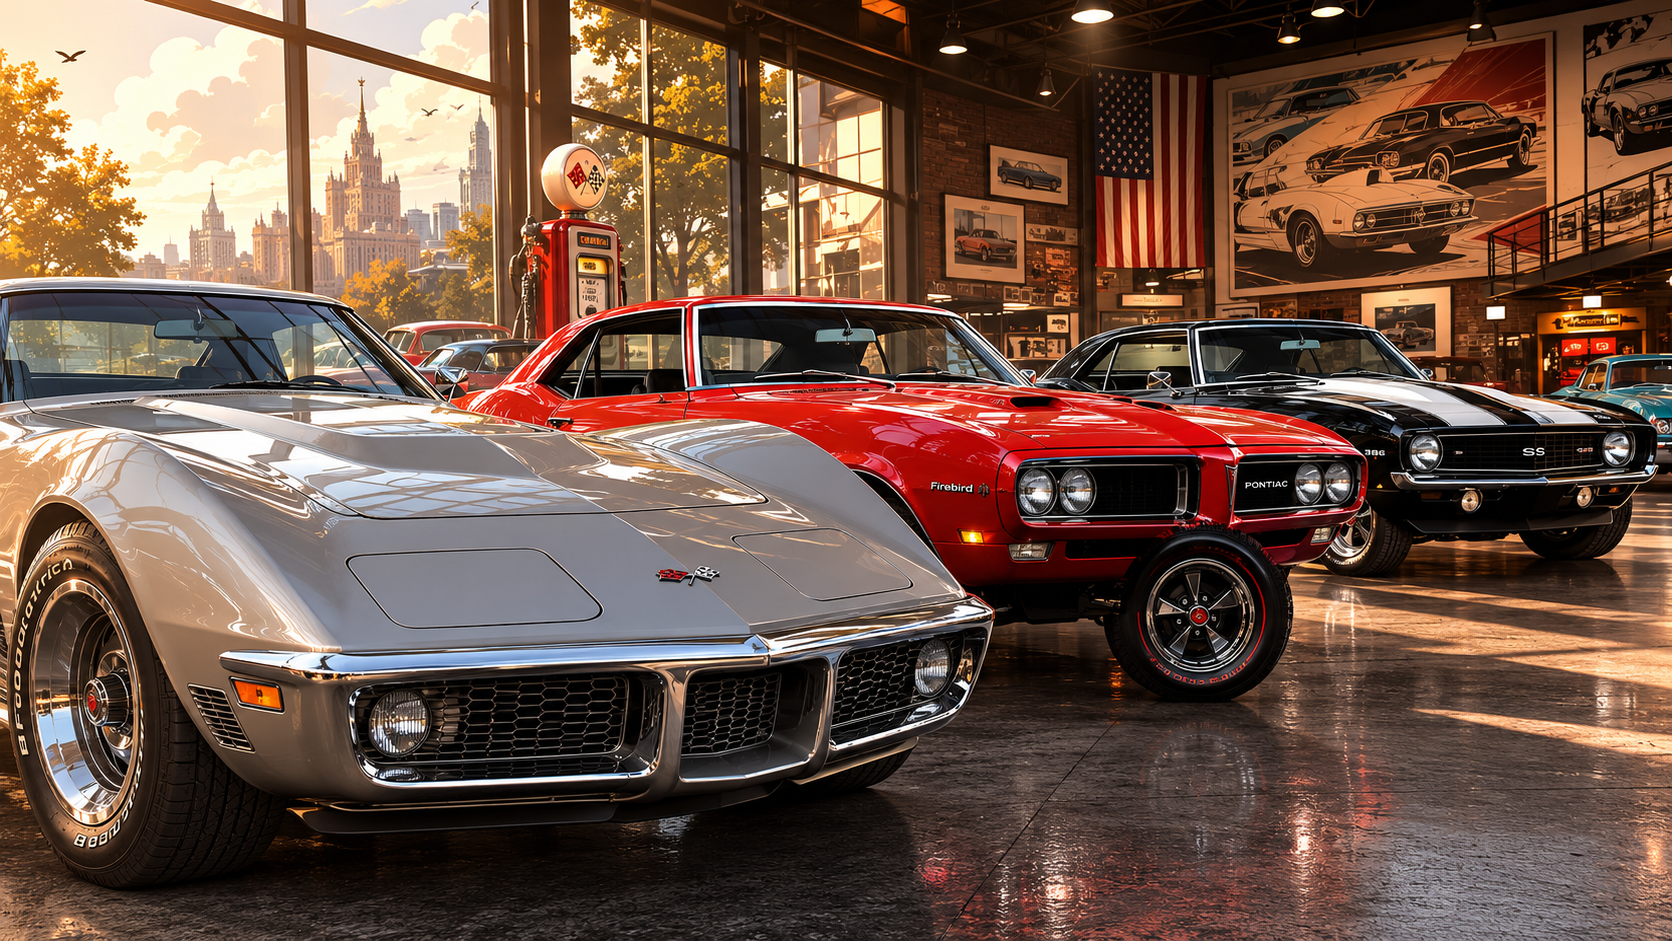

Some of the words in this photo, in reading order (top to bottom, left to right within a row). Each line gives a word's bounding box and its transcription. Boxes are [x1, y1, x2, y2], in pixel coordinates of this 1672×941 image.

[1522, 447, 1546, 457] SS
[930, 481, 974, 493] Firebird
[1245, 480, 1288, 489] PONTIAC
